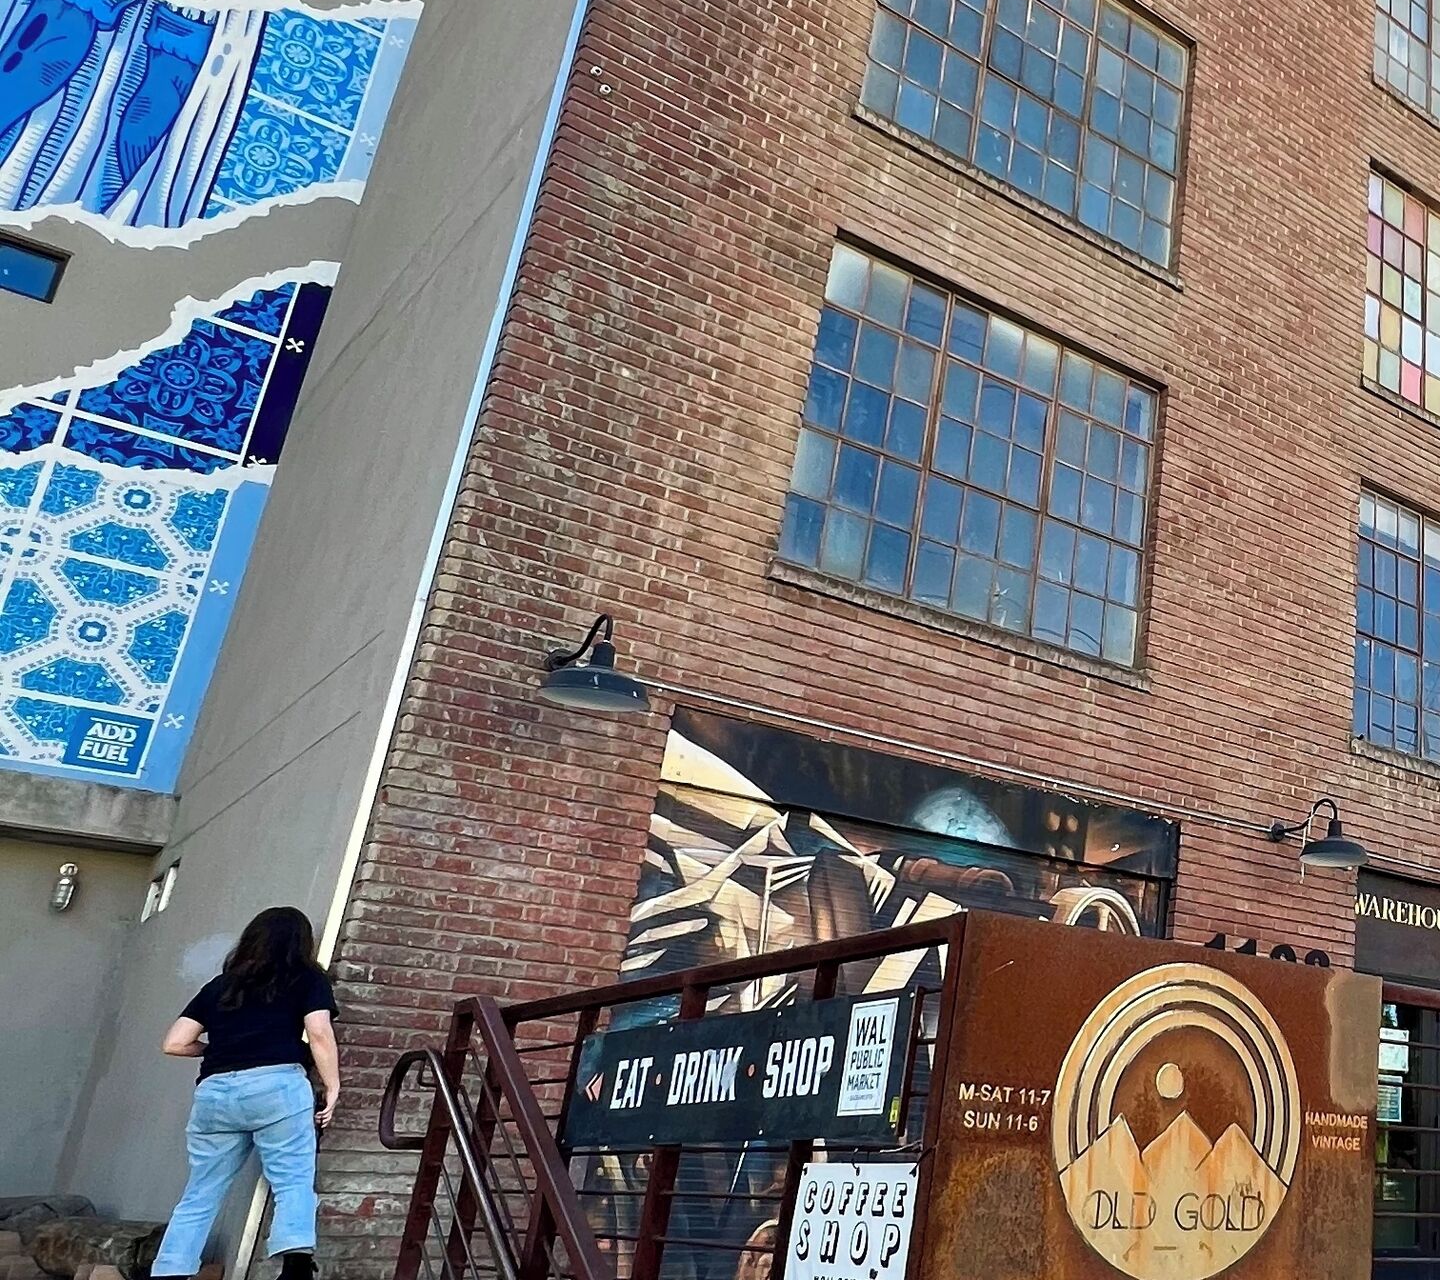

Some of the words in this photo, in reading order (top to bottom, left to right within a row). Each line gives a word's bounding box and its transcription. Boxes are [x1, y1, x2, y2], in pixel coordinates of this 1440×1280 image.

[86, 722, 137, 743] ADD
[78, 740, 129, 762] FUEL
[855, 1015, 887, 1048] WAL
[850, 1048, 885, 1071] PUBLIC
[609, 1056, 654, 1111] EAT
[666, 1046, 743, 1106] DRINK
[762, 1035, 835, 1099] SHOP
[846, 1072, 881, 1092] MARKET
[959, 1083, 1014, 1103] M-SAT
[1019, 1088, 1051, 1106] 11-7
[964, 1110, 1000, 1130] SUN
[1006, 1114, 1038, 1132] 11-6
[1305, 1111, 1368, 1129] HANDMADE
[1312, 1135, 1360, 1151] VINTAGE
[804, 1181, 907, 1218] COFFEE
[1082, 1190, 1157, 1230] OLD
[1174, 1192, 1265, 1231] GOLD
[796, 1220, 900, 1268] SHOP
